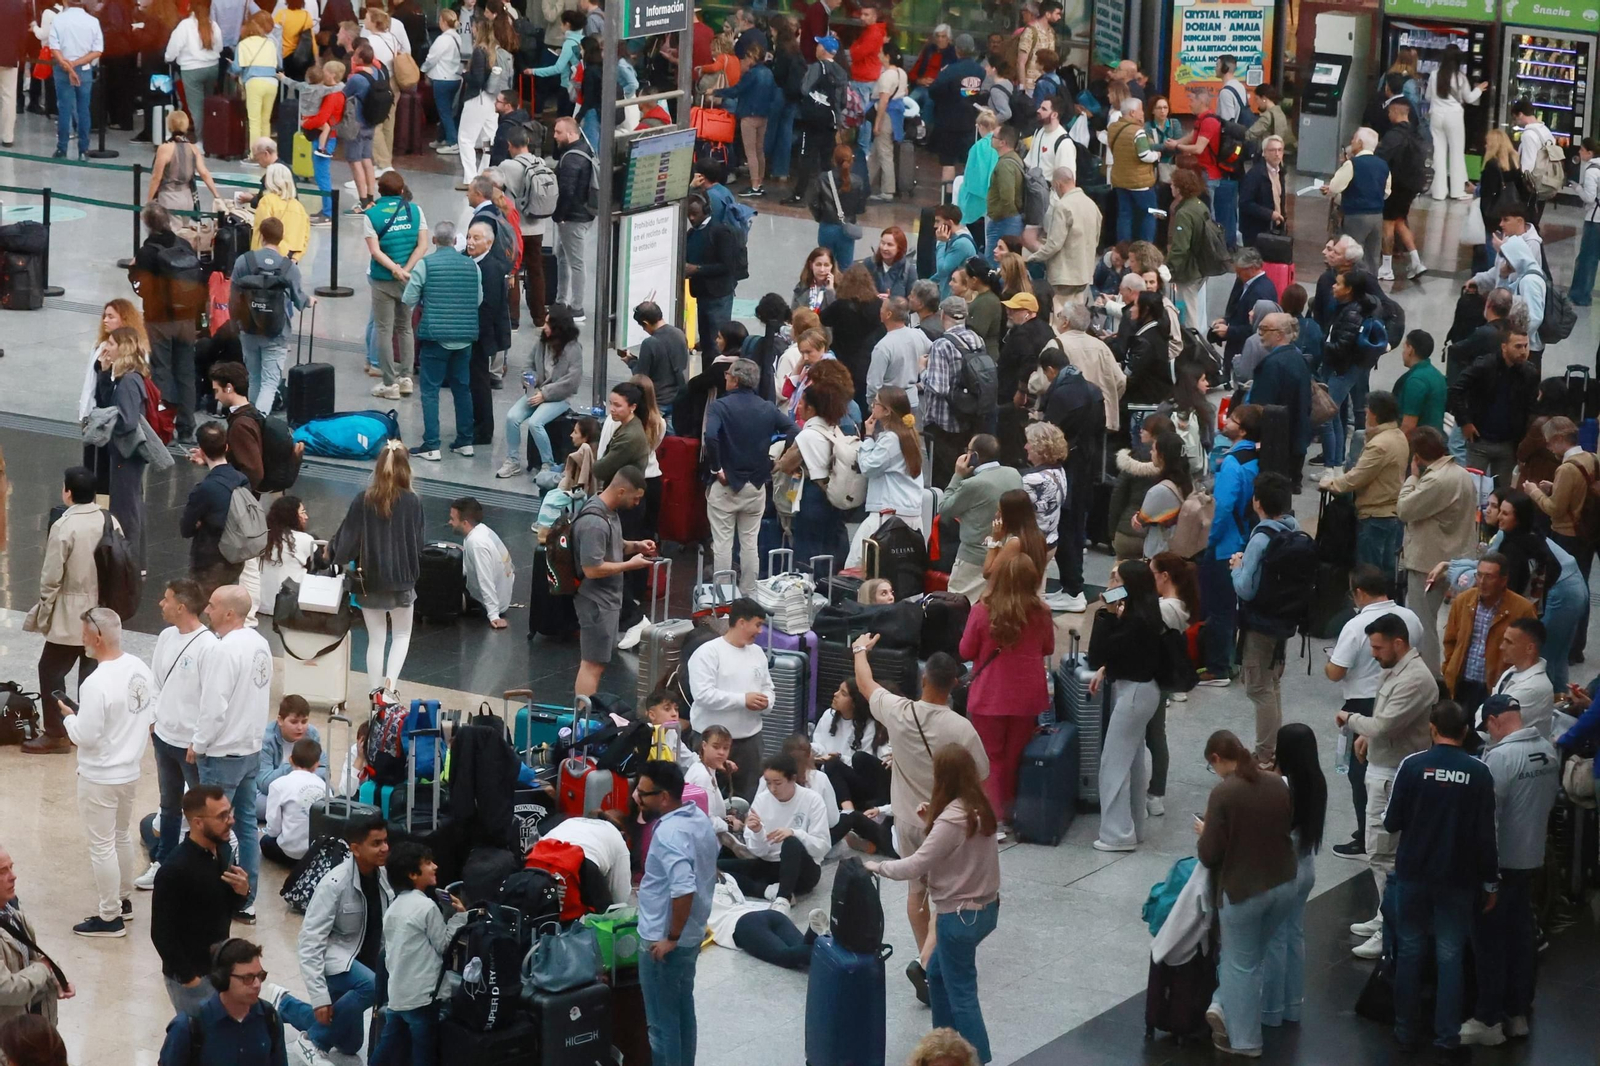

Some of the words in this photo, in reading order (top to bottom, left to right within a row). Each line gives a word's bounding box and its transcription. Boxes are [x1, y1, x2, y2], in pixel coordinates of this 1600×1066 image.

[646, 0, 684, 17] Información
[1184, 10, 1220, 19] CRYSTAL
[1223, 10, 1263, 19] FIGHTERS
[1532, 4, 1571, 17] Snacks
[1186, 22, 1221, 32] DORIAN
[1229, 22, 1260, 32] AMAIA
[1423, 767, 1471, 785] FENDI
